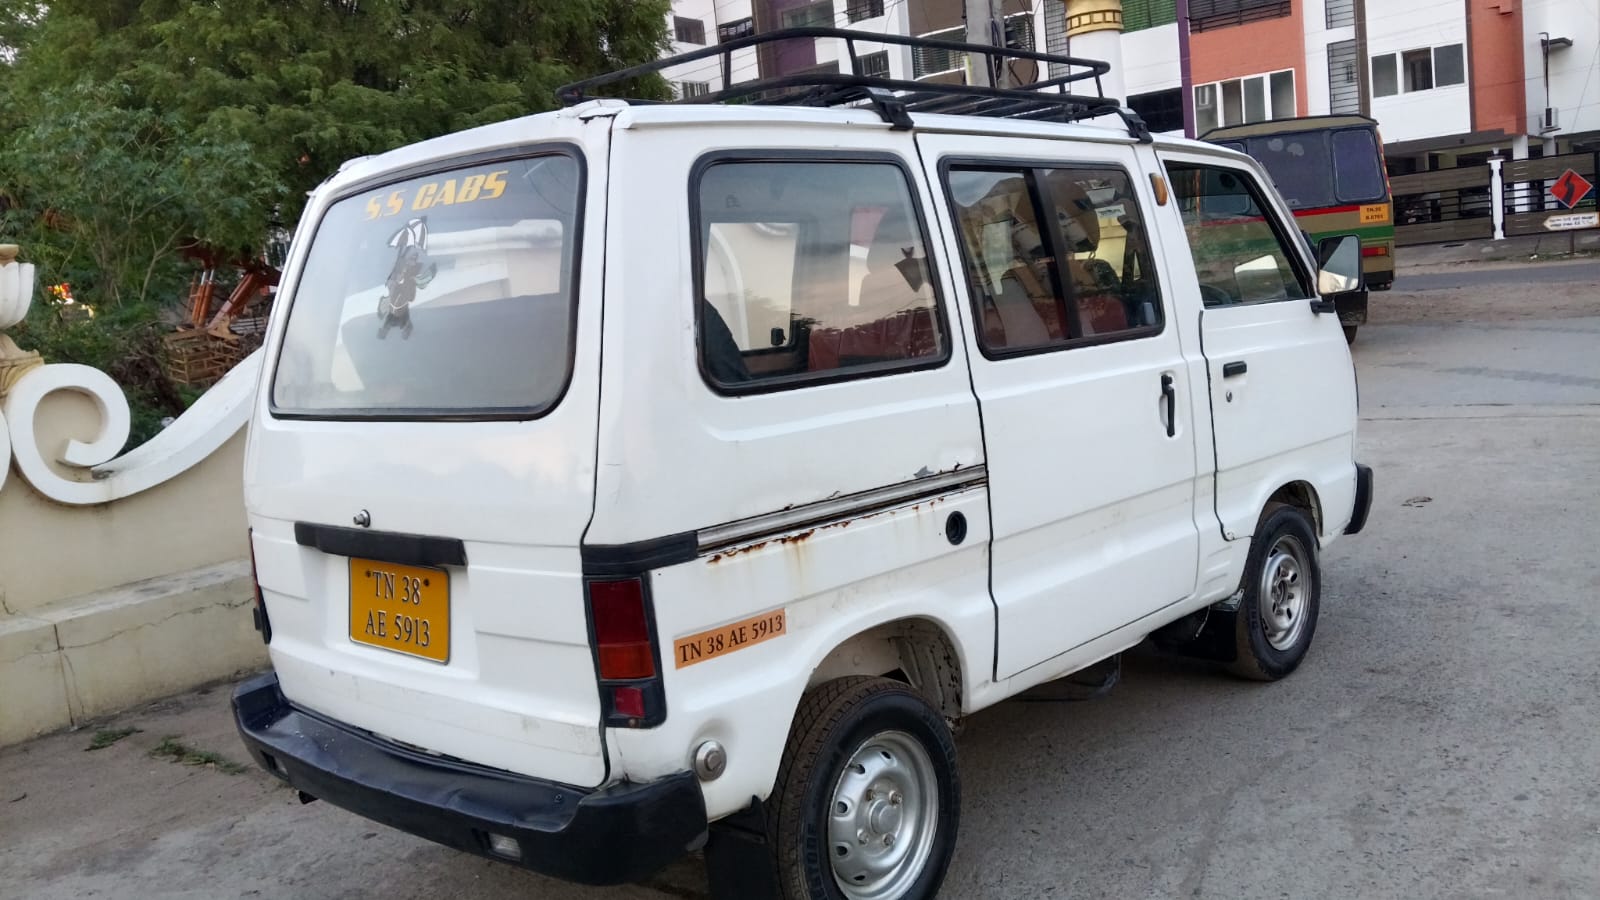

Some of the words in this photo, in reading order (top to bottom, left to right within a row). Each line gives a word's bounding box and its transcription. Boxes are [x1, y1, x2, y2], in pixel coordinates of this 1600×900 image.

[412, 170, 510, 211] CABS
[372, 569, 396, 600] TN
[401, 575, 421, 606] 38
[365, 608, 388, 638] AE
[394, 613, 431, 648] 5913
[679, 640, 703, 663] TN
[706, 634, 724, 655] 38
[728, 625, 748, 648] AE
[751, 615, 783, 640] 5913
